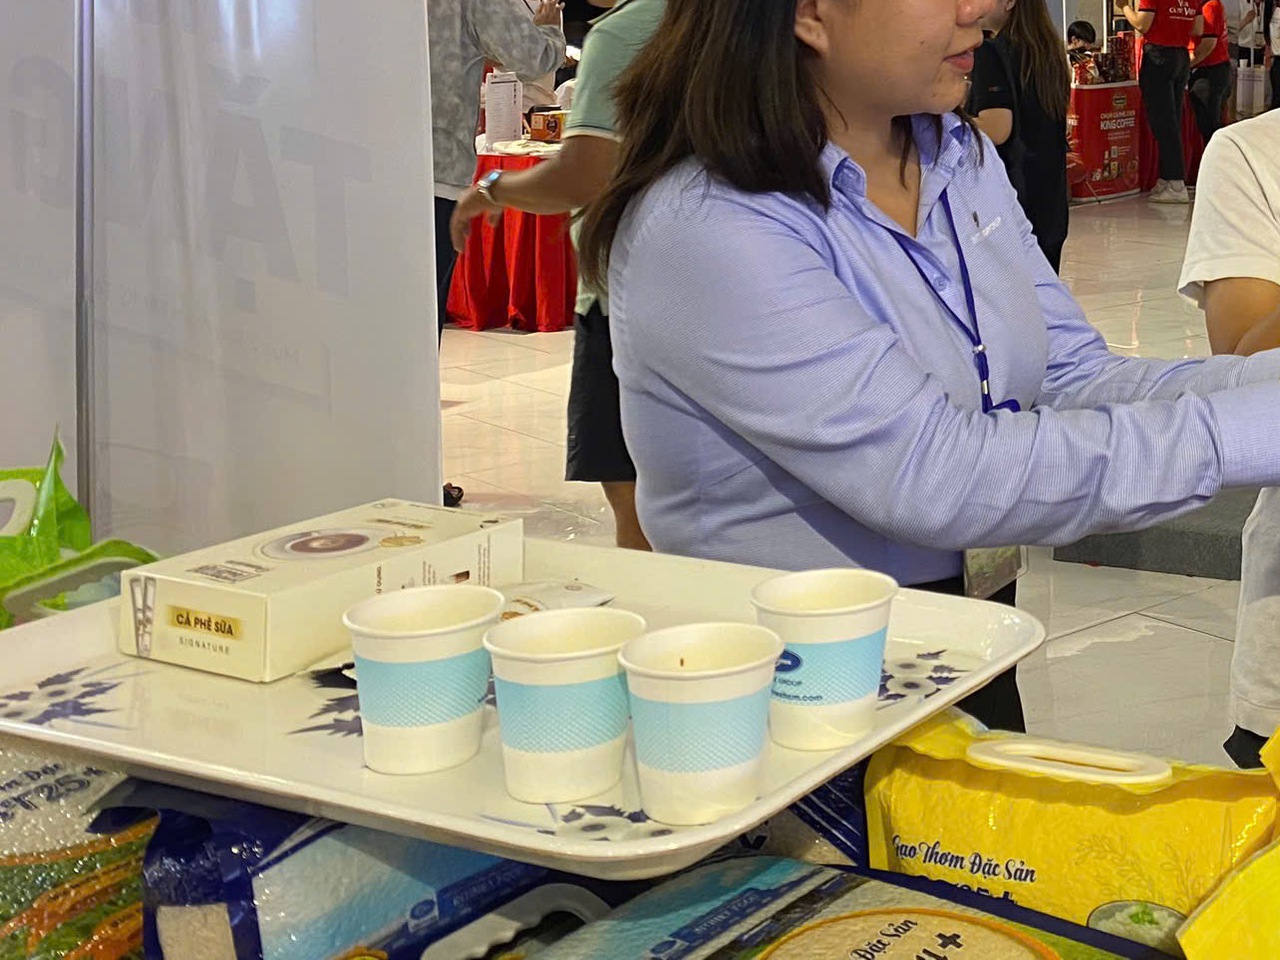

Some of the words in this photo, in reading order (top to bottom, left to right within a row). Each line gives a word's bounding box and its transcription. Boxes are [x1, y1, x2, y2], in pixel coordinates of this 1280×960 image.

[176, 611, 191, 627] CÀ
[194, 617, 212, 631] PHÊ
[214, 620, 234, 636] SỮA
[179, 636, 230, 655] SIGNATURE
[918, 841, 965, 870] Thơm
[969, 852, 1001, 880] Đặc
[1004, 859, 1036, 883] Sản
[851, 939, 890, 960] Đặc
[880, 919, 918, 938] Sản
